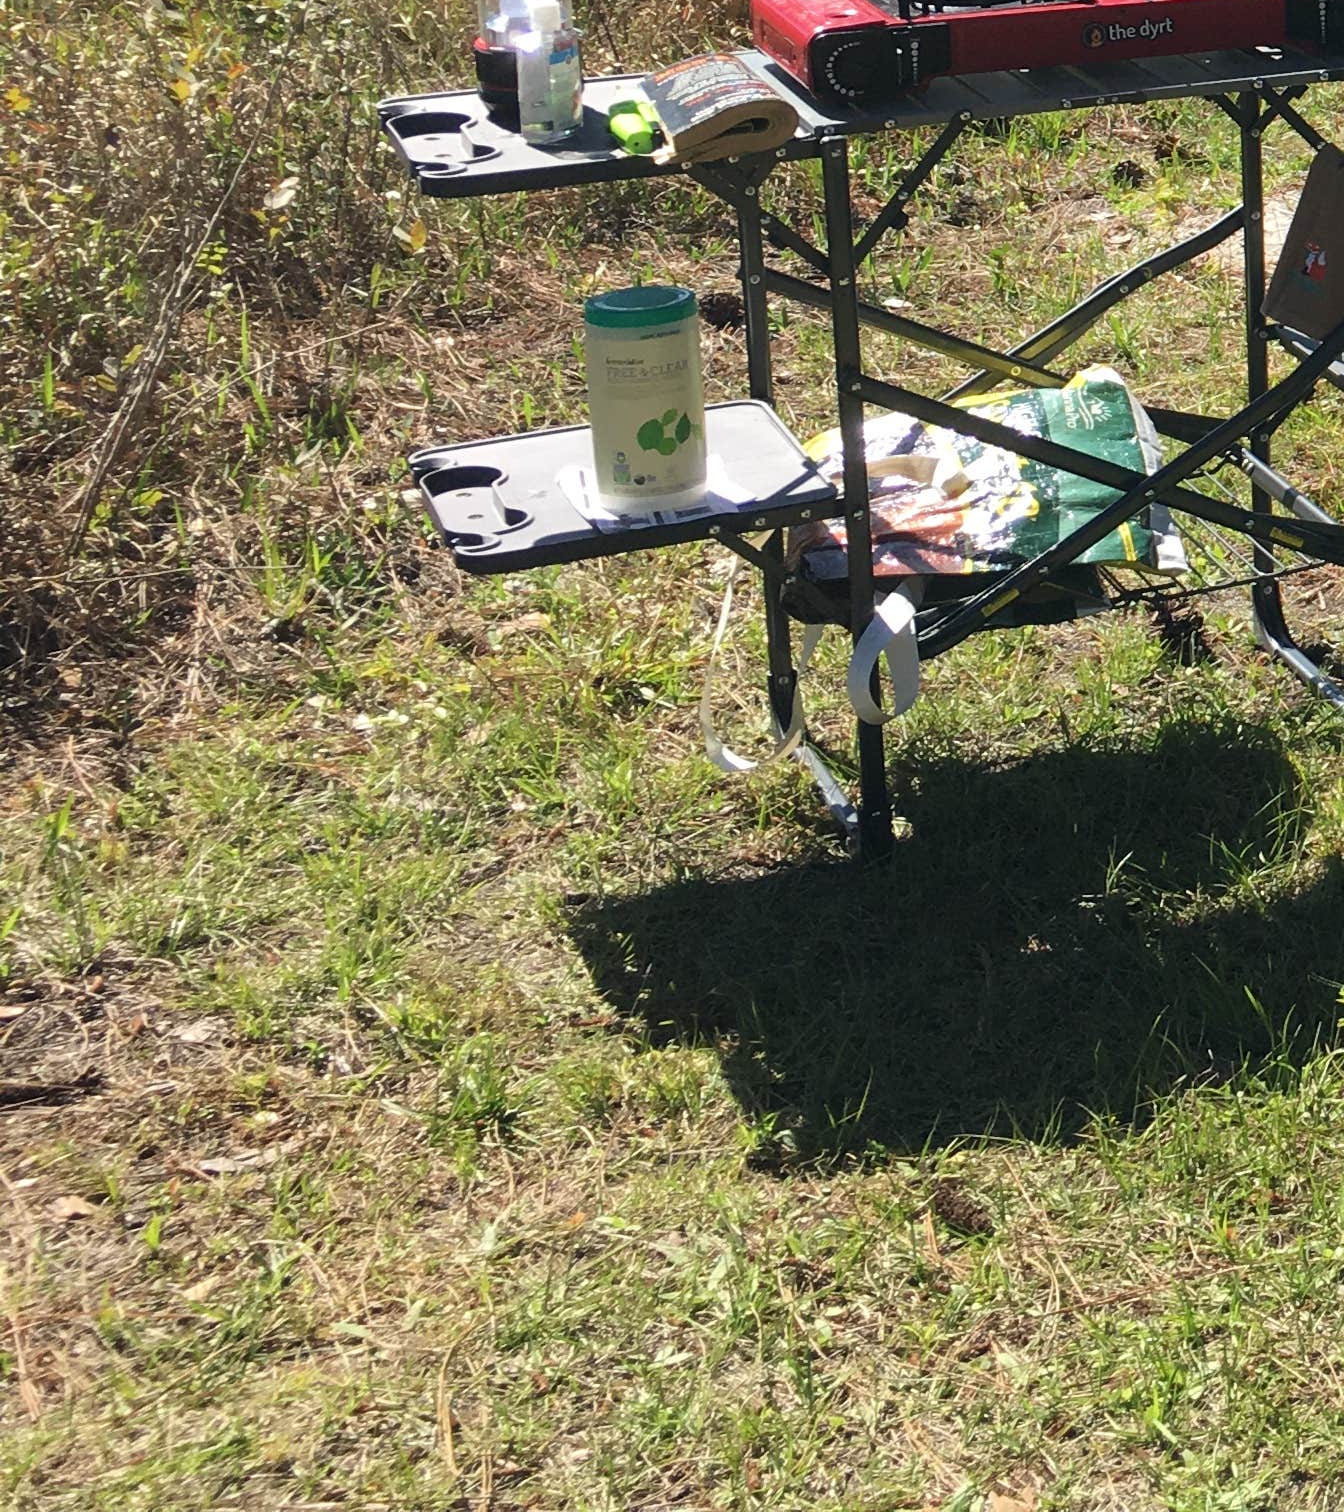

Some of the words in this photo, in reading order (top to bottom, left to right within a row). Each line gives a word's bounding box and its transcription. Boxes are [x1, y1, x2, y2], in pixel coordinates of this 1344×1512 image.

[1108, 23, 1137, 41] the
[1140, 17, 1173, 40] dyrt
[650, 359, 689, 377] CLEAR
